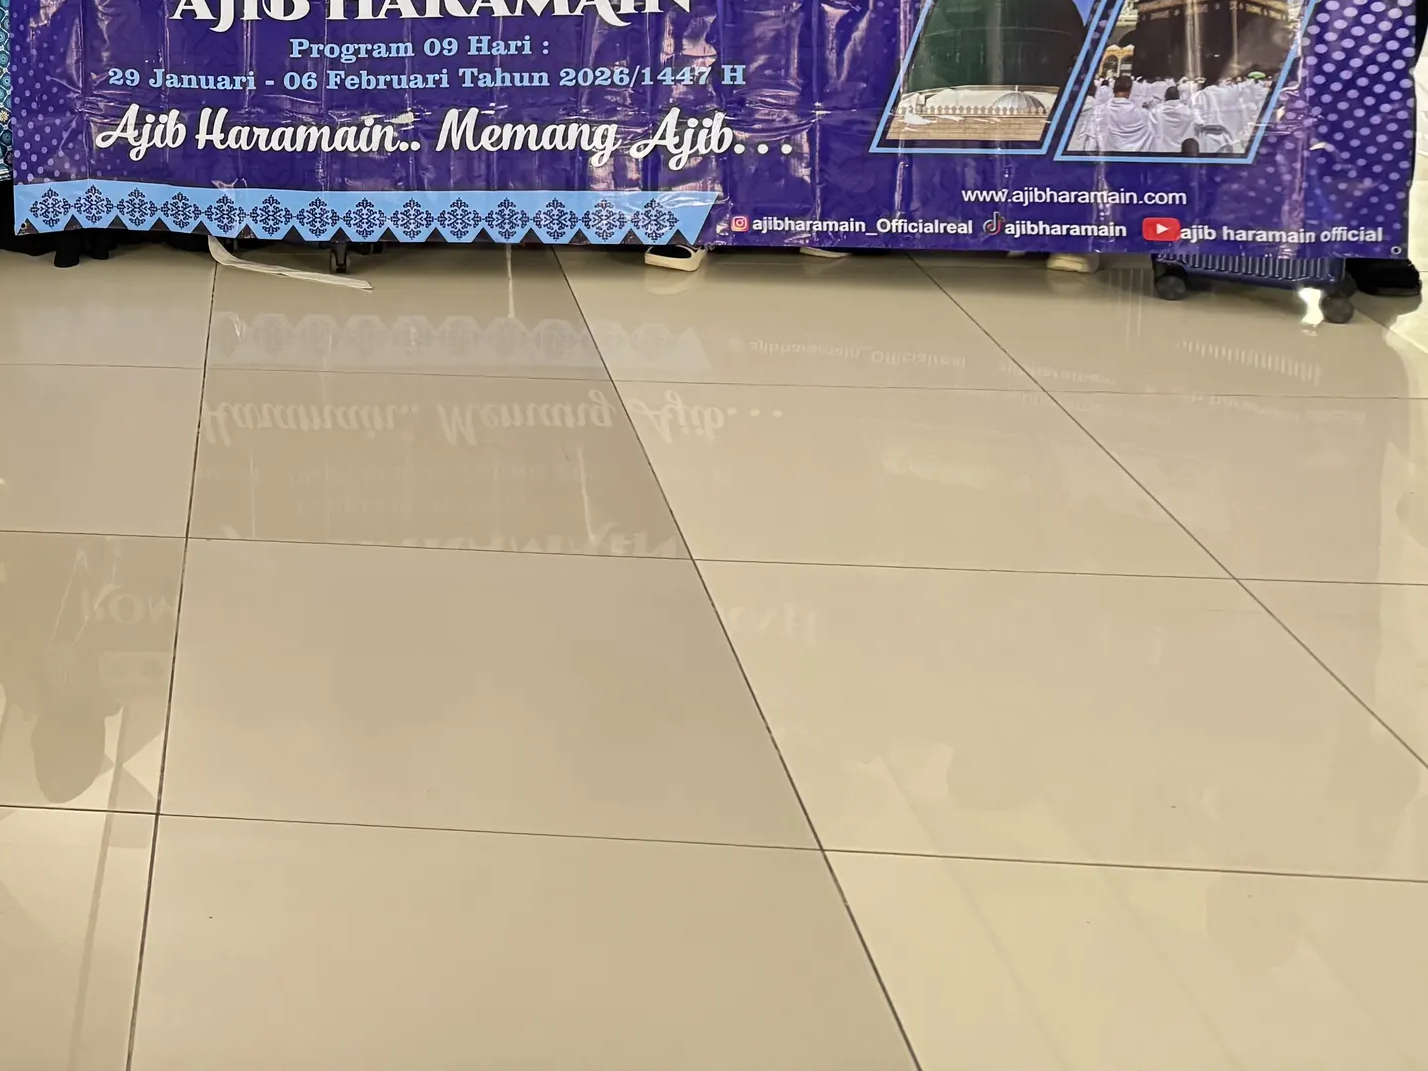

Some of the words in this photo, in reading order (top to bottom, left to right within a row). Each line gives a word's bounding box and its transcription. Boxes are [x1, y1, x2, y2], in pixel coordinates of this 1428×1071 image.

[289, 37, 417, 61] Program
[423, 37, 459, 59] 09
[468, 35, 532, 57] Hari
[108, 68, 140, 89] 29
[148, 68, 256, 91] Januari
[283, 70, 318, 91] 06
[326, 68, 450, 91] Februari
[459, 67, 551, 90] Tahun
[559, 63, 711, 91] 2026/1447
[721, 65, 747, 85] H
[95, 103, 184, 161] Ajib
[195, 109, 422, 154] Haramain..
[434, 108, 621, 163] Memang
[629, 108, 794, 171] Ajib...
[961, 188, 1188, 207] www.ajibharamain.com
[752, 214, 974, 236] ajibharamain_Officialreal
[1004, 220, 1128, 241] ajibharamain
[1180, 225, 1217, 243] ajib
[1222, 226, 1316, 244] haramain
[1320, 226, 1384, 244] official
